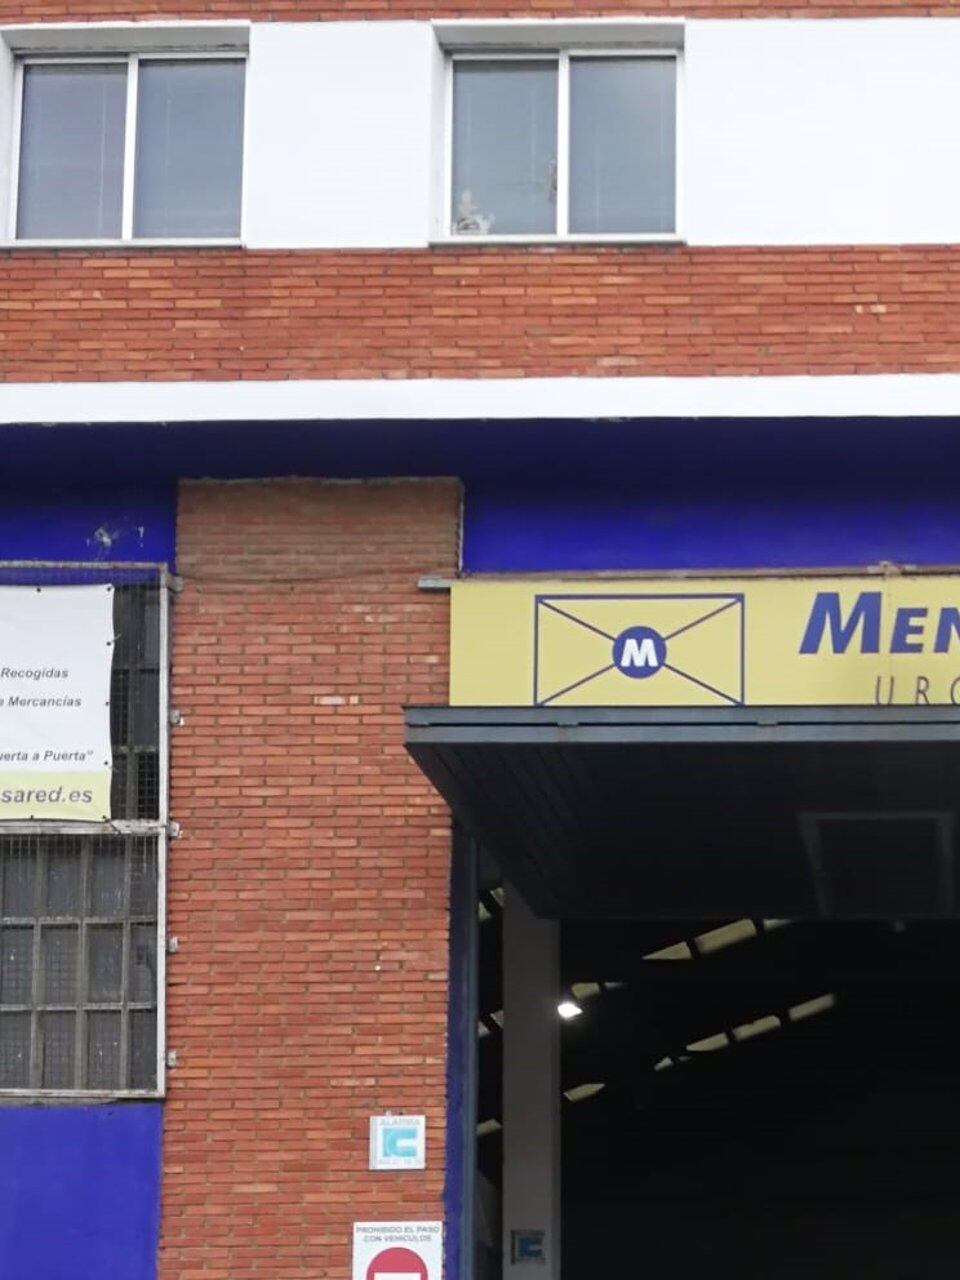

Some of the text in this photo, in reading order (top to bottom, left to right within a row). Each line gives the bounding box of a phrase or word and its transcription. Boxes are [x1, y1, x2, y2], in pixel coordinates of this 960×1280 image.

[621, 636, 658, 668] M
[1, 667, 69, 680] Recogidas
[32, 752, 40, 761] a
[1, 786, 93, 803] sared.es
